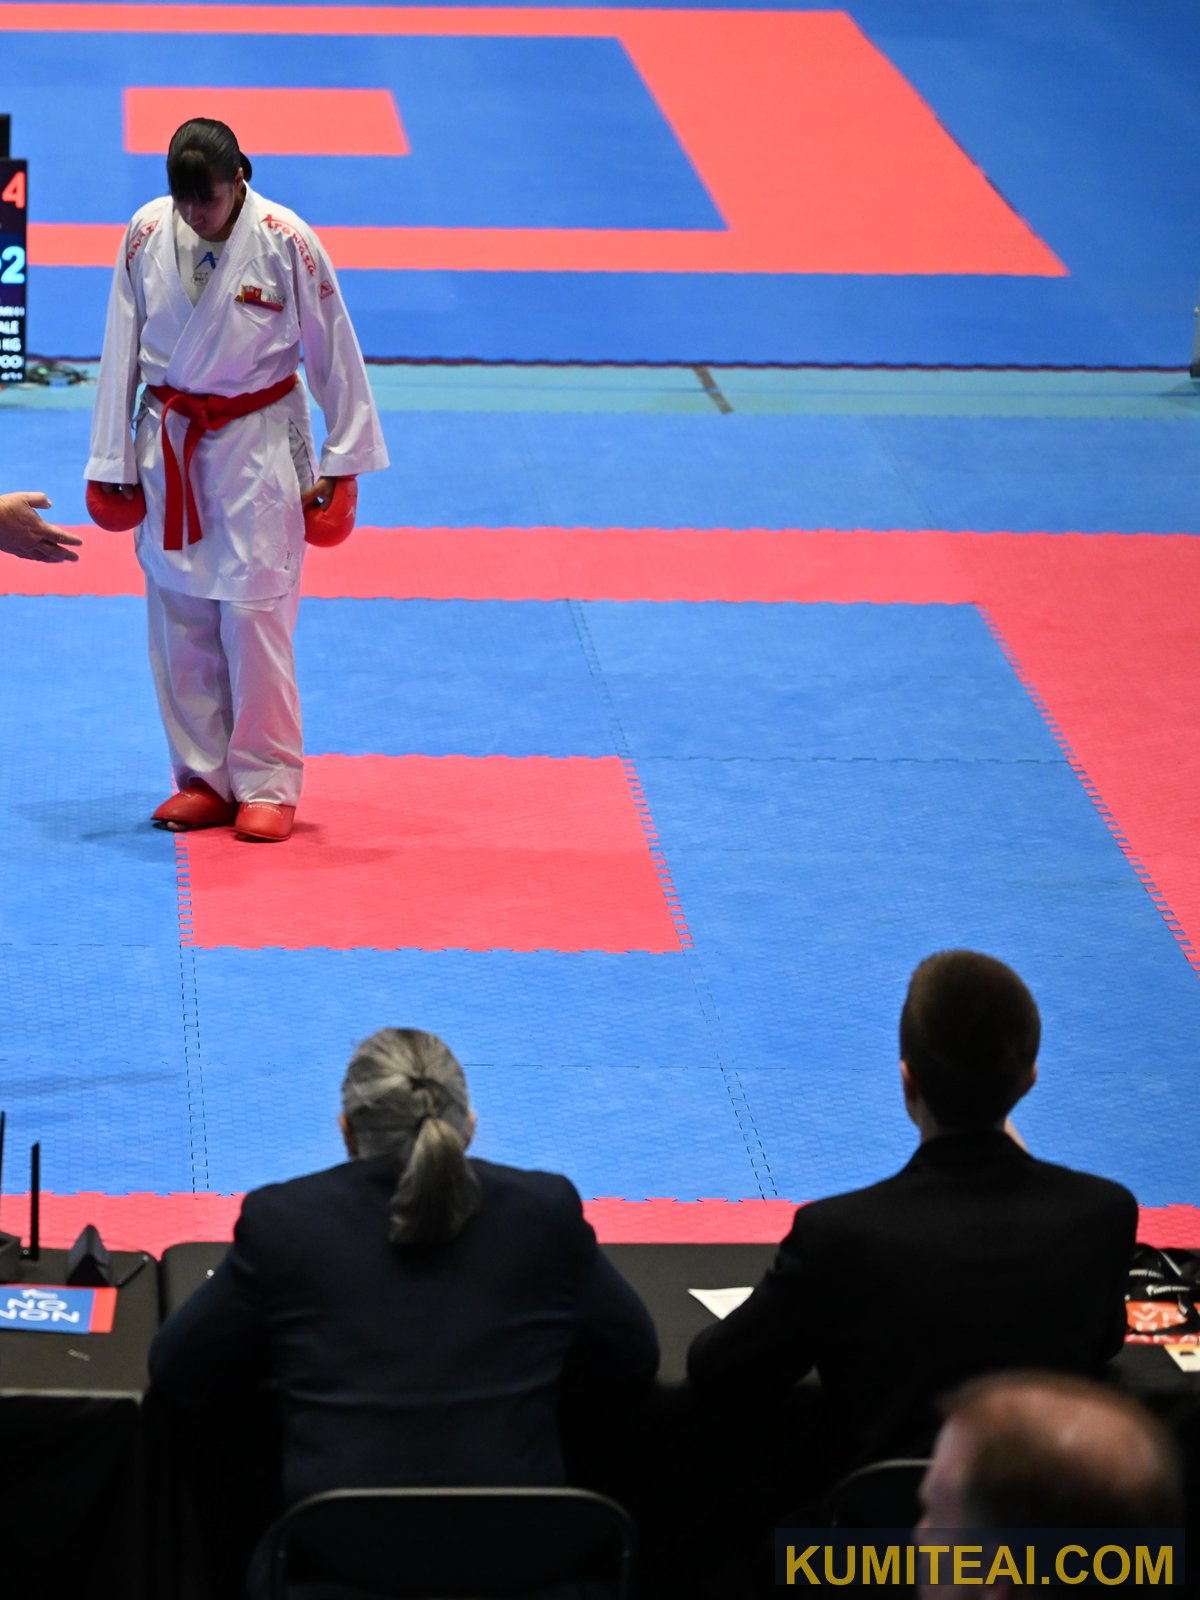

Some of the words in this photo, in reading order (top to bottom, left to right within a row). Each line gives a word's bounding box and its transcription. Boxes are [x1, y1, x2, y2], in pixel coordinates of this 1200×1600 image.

[1, 170, 26, 209] 4
[260, 213, 318, 277] Arawaza
[2, 337, 22, 353] KG
[6, 1297, 68, 1312] NO
